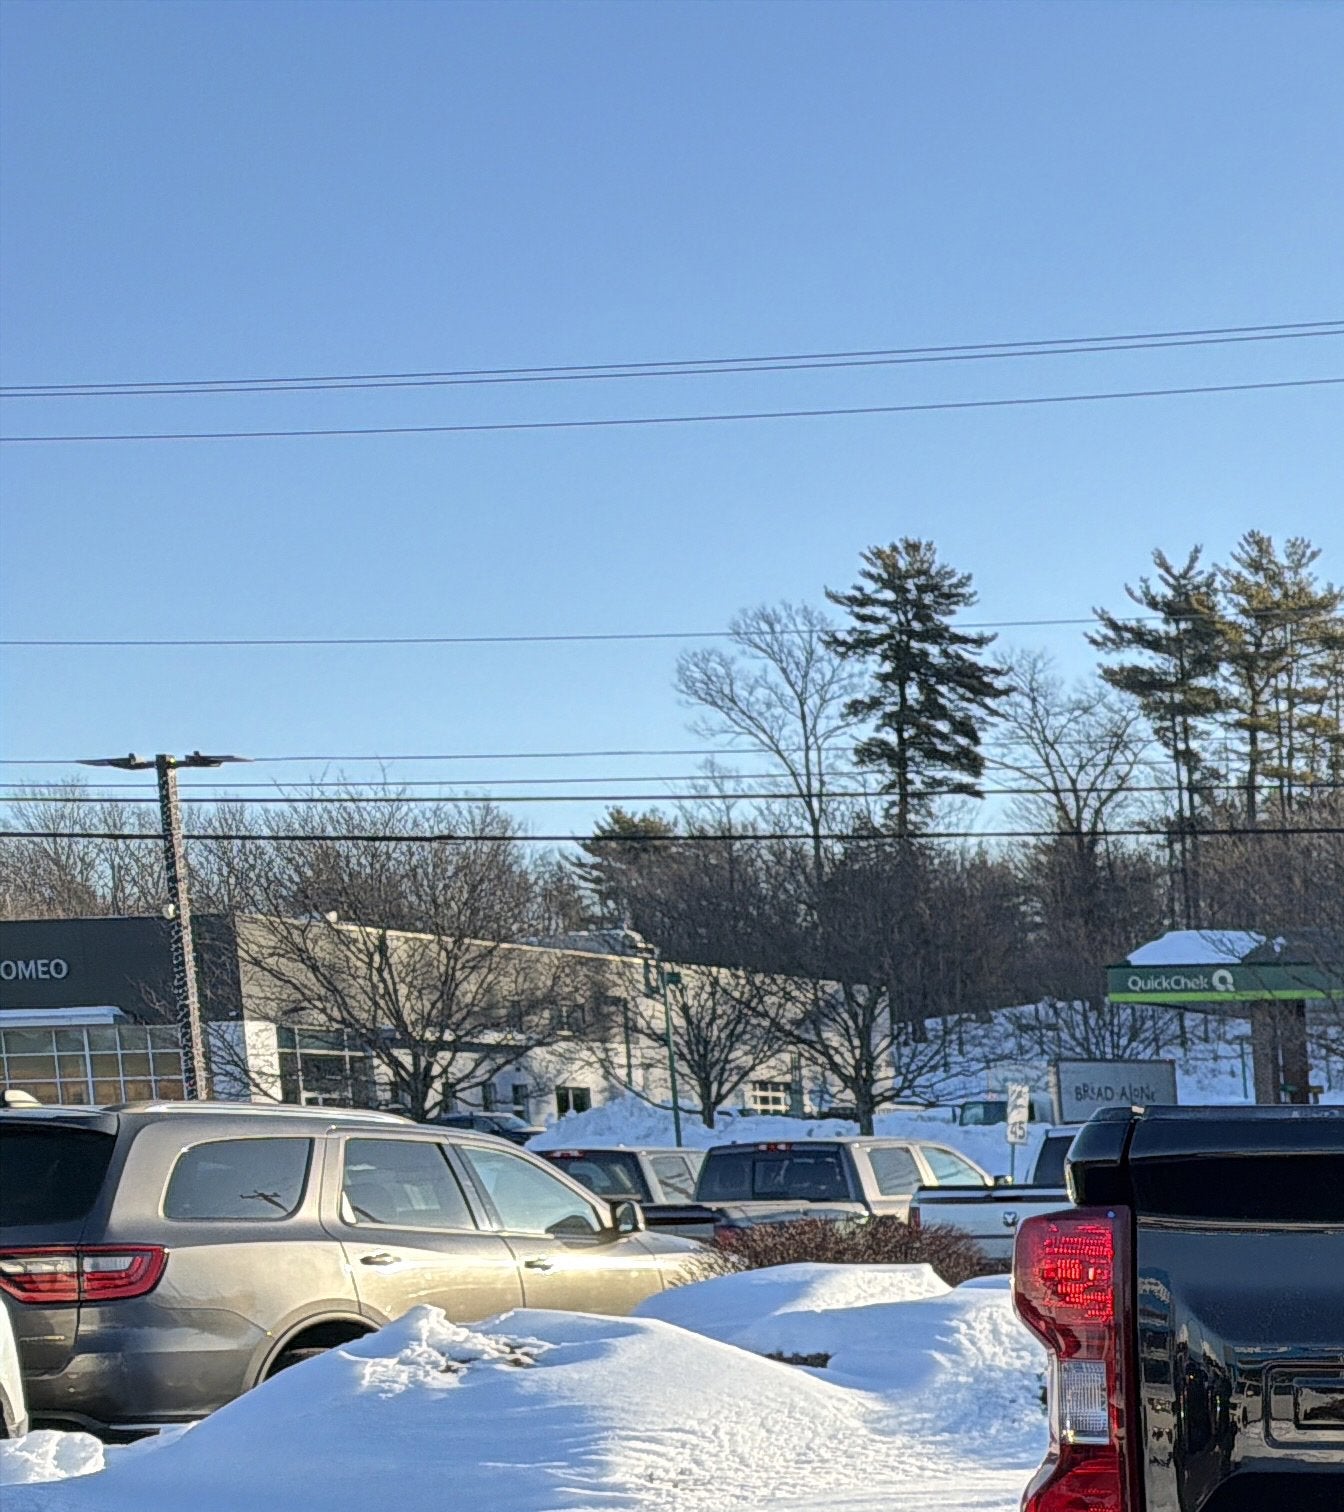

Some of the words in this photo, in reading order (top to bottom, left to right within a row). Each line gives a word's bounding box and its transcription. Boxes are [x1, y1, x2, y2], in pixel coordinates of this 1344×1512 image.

[1127, 975, 1209, 992] QuickChek
[1075, 1082, 1115, 1102] BREAD
[1010, 1121, 1026, 1140] 45
